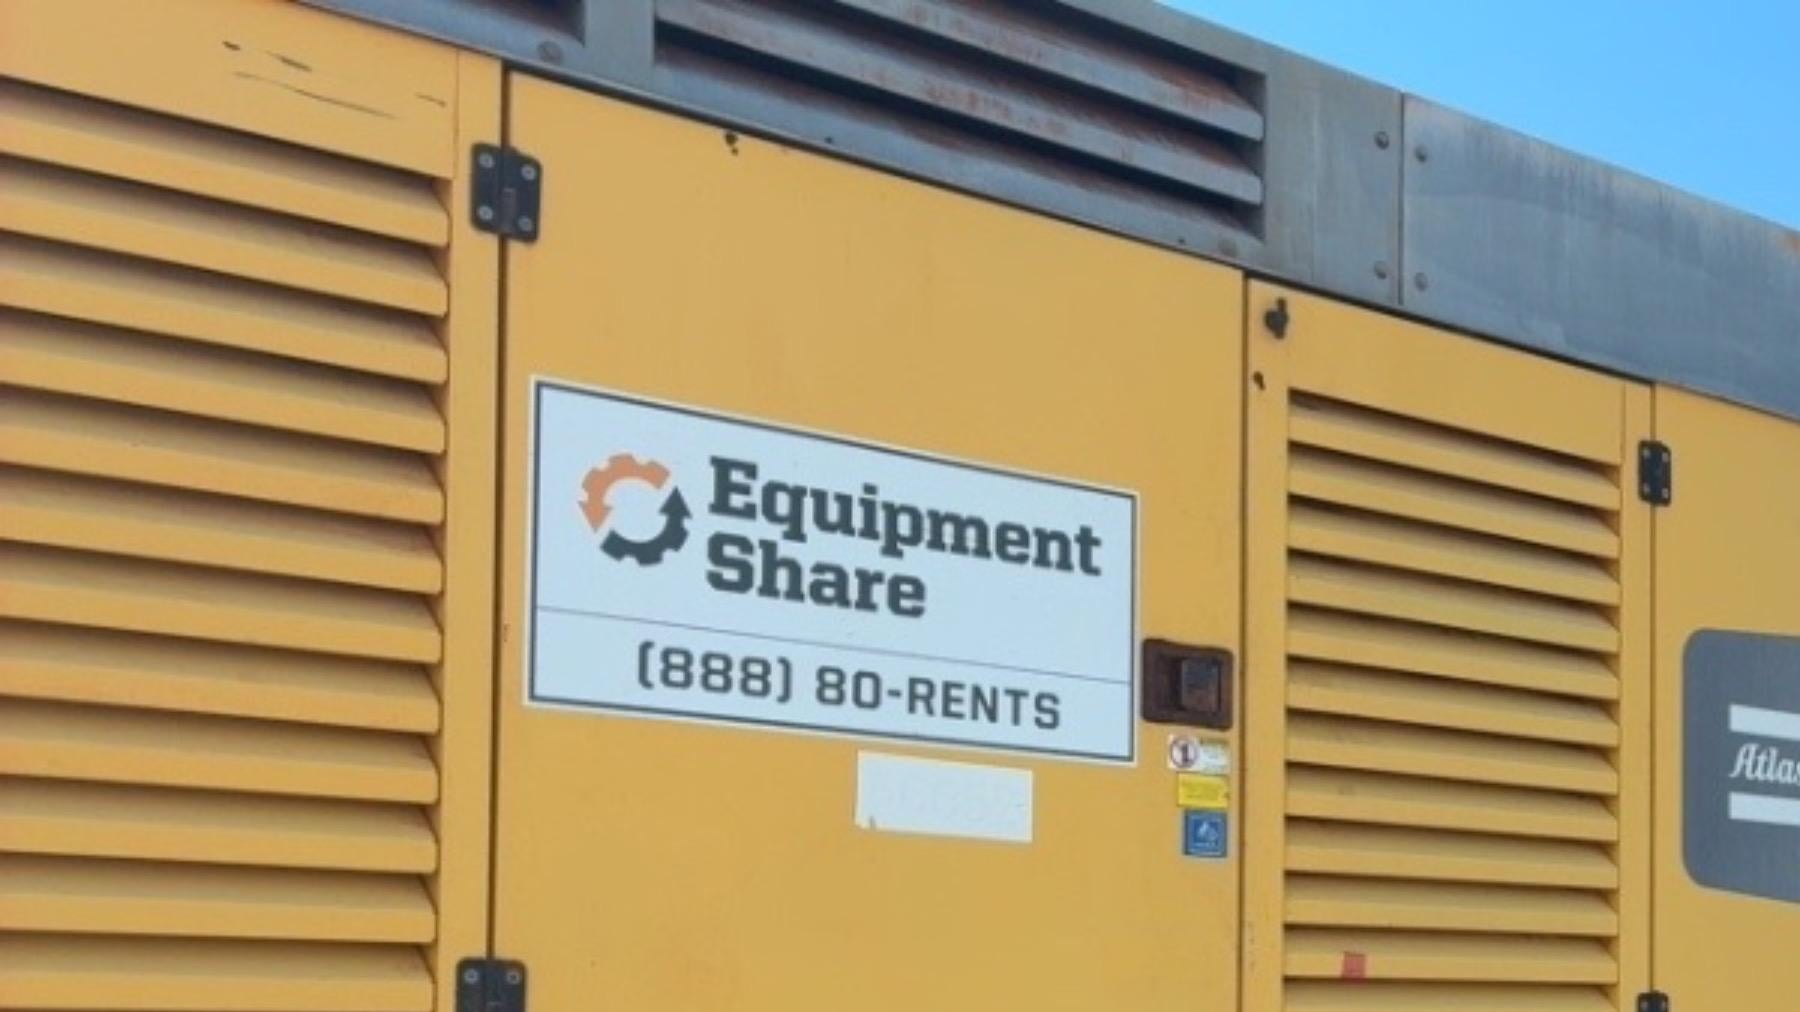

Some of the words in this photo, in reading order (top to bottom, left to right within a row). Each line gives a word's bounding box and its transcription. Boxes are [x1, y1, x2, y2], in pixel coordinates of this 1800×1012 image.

[708, 455, 1103, 577] Equipment
[706, 531, 927, 618] Share
[637, 641, 793, 702] (888)
[815, 666, 1062, 731] 80-RENTS
